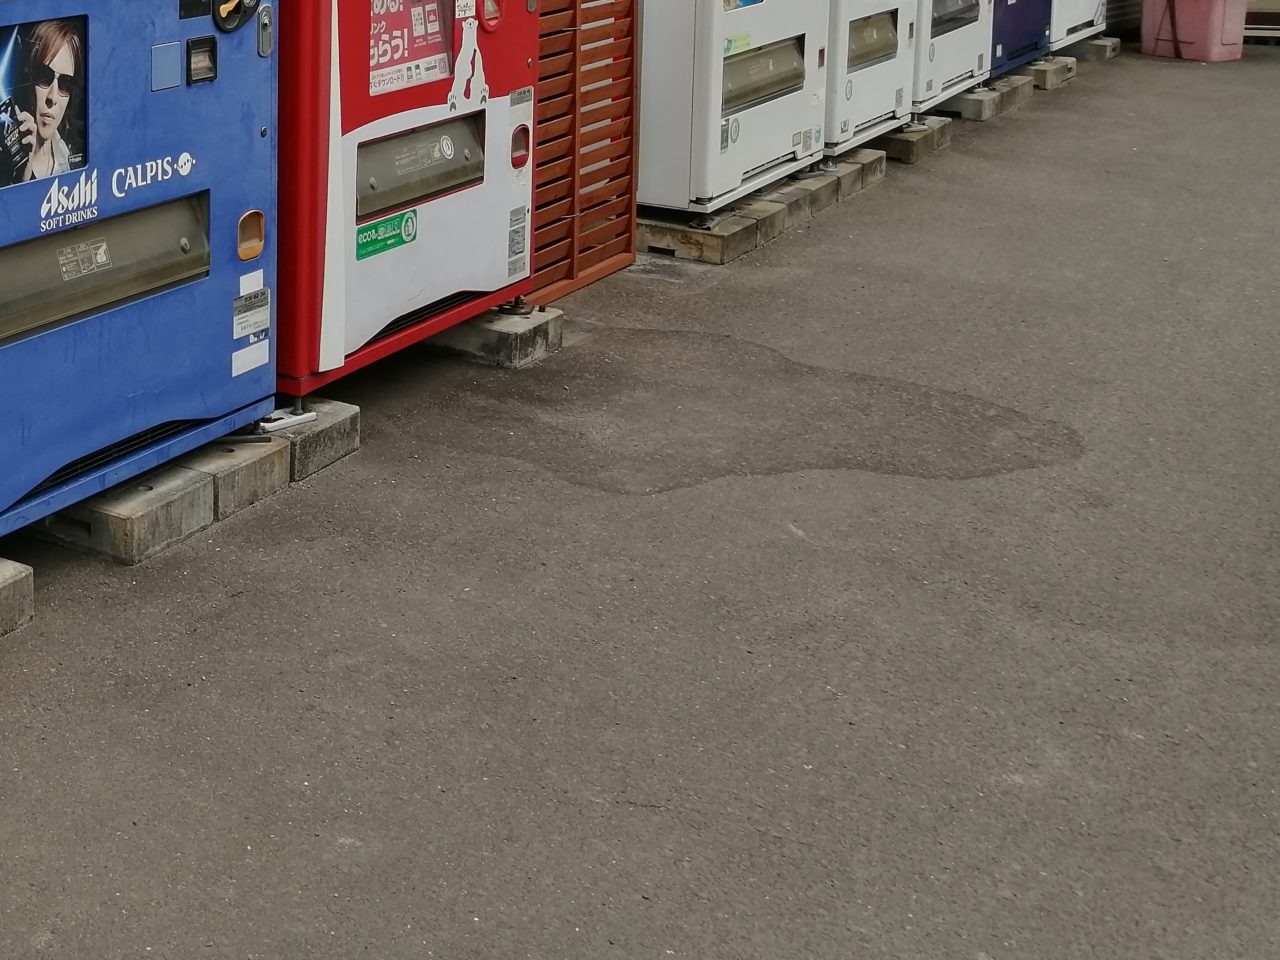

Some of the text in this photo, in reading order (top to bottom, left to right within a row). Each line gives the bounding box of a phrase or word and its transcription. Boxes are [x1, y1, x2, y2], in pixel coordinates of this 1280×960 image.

[40, 168, 98, 219] Asahi
[111, 156, 173, 198] CALPIS
[40, 206, 98, 233] SOFT DRINKS
